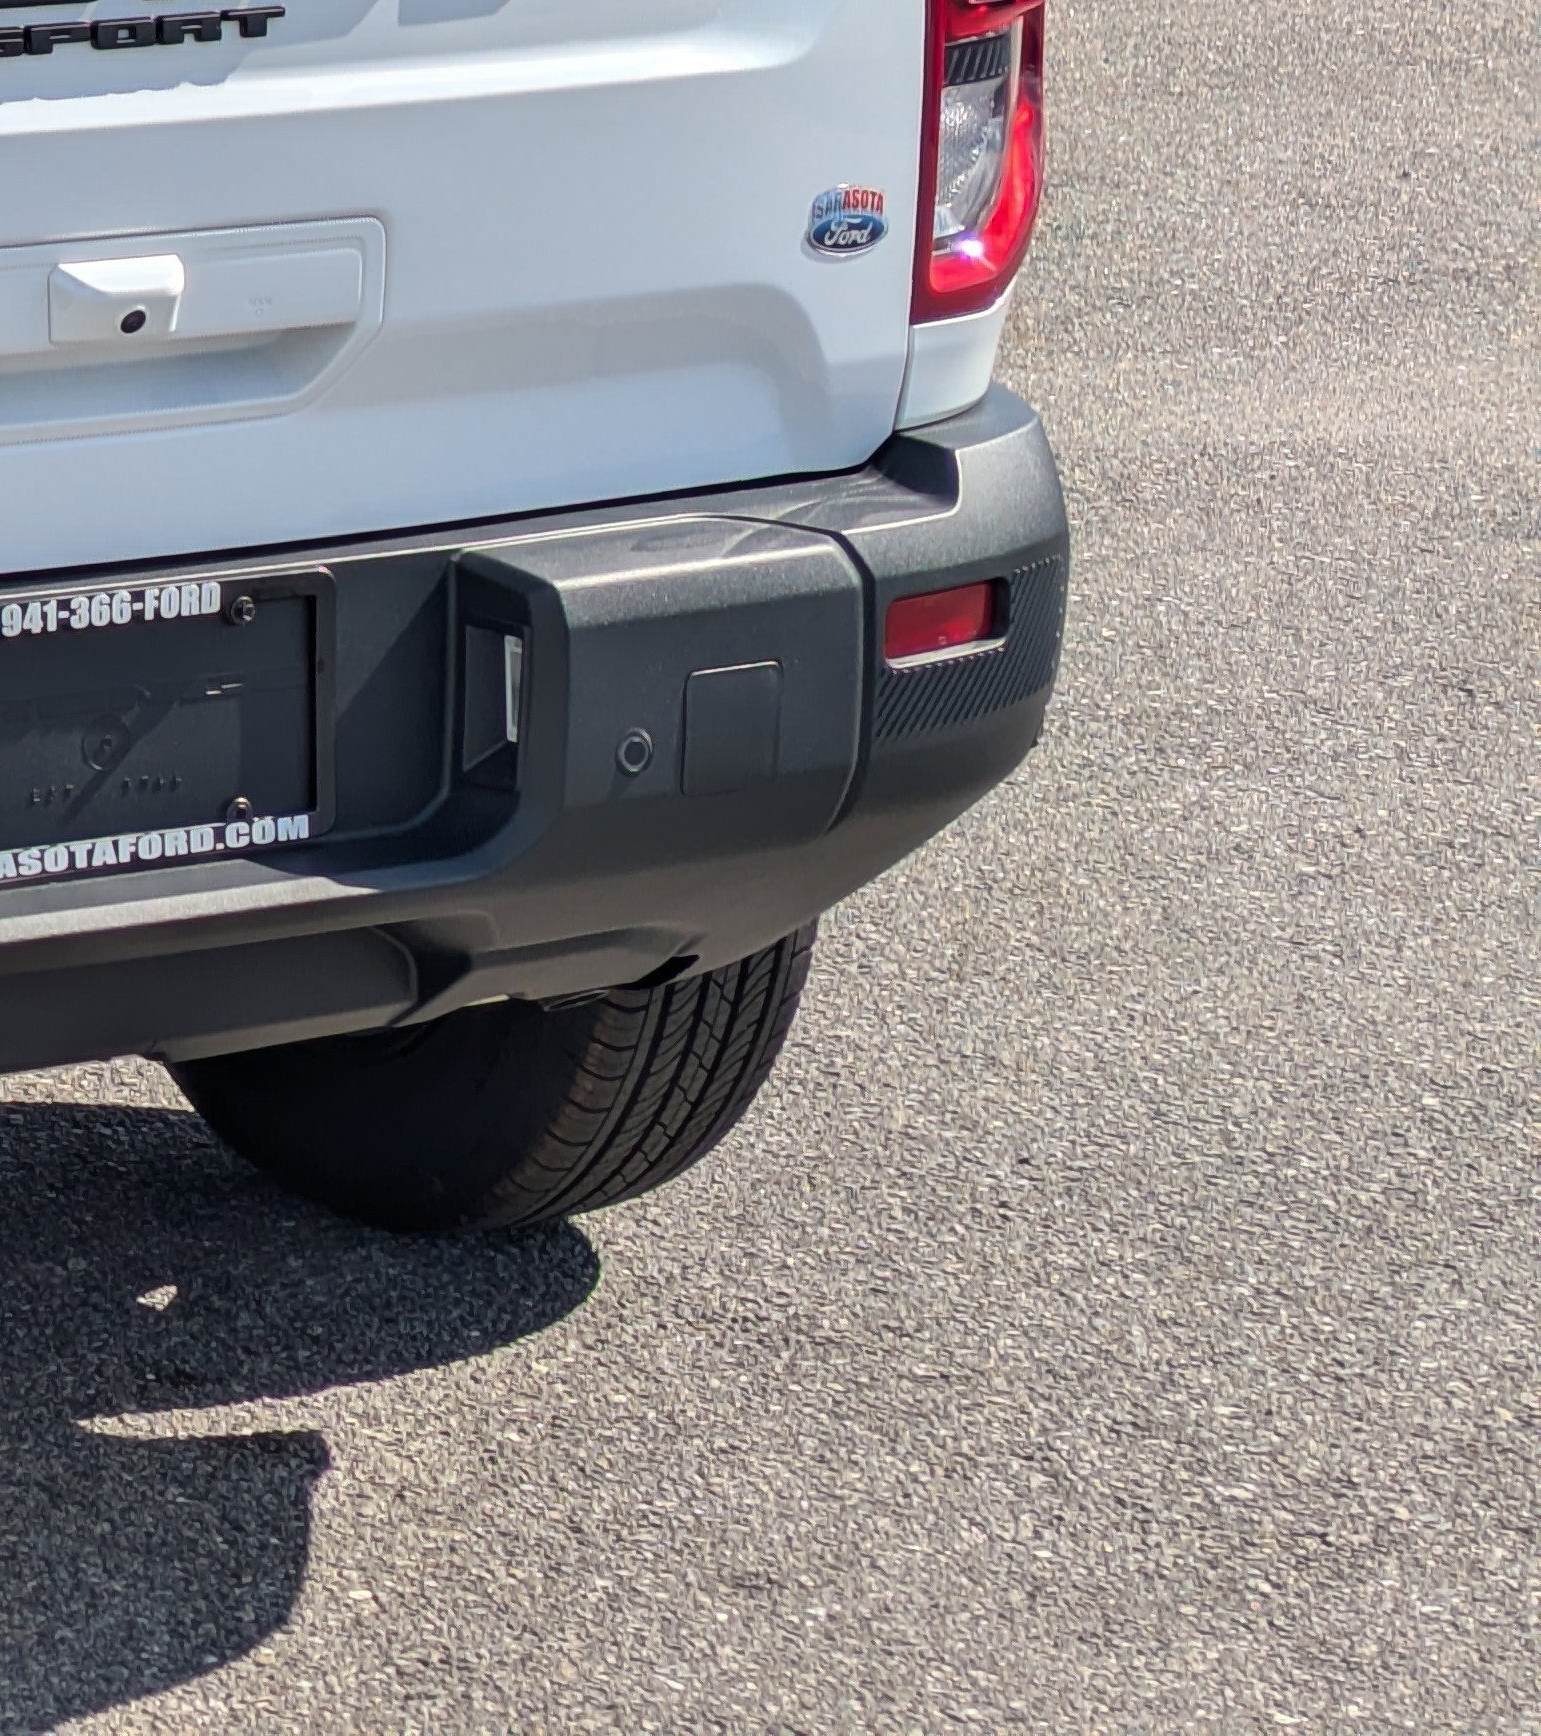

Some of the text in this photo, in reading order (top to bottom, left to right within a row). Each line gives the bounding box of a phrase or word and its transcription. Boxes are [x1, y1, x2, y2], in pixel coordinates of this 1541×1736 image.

[813, 189, 884, 219] SARASOTA
[824, 217, 873, 246] Ford
[1, 581, 221, 638] 941-366-FORD
